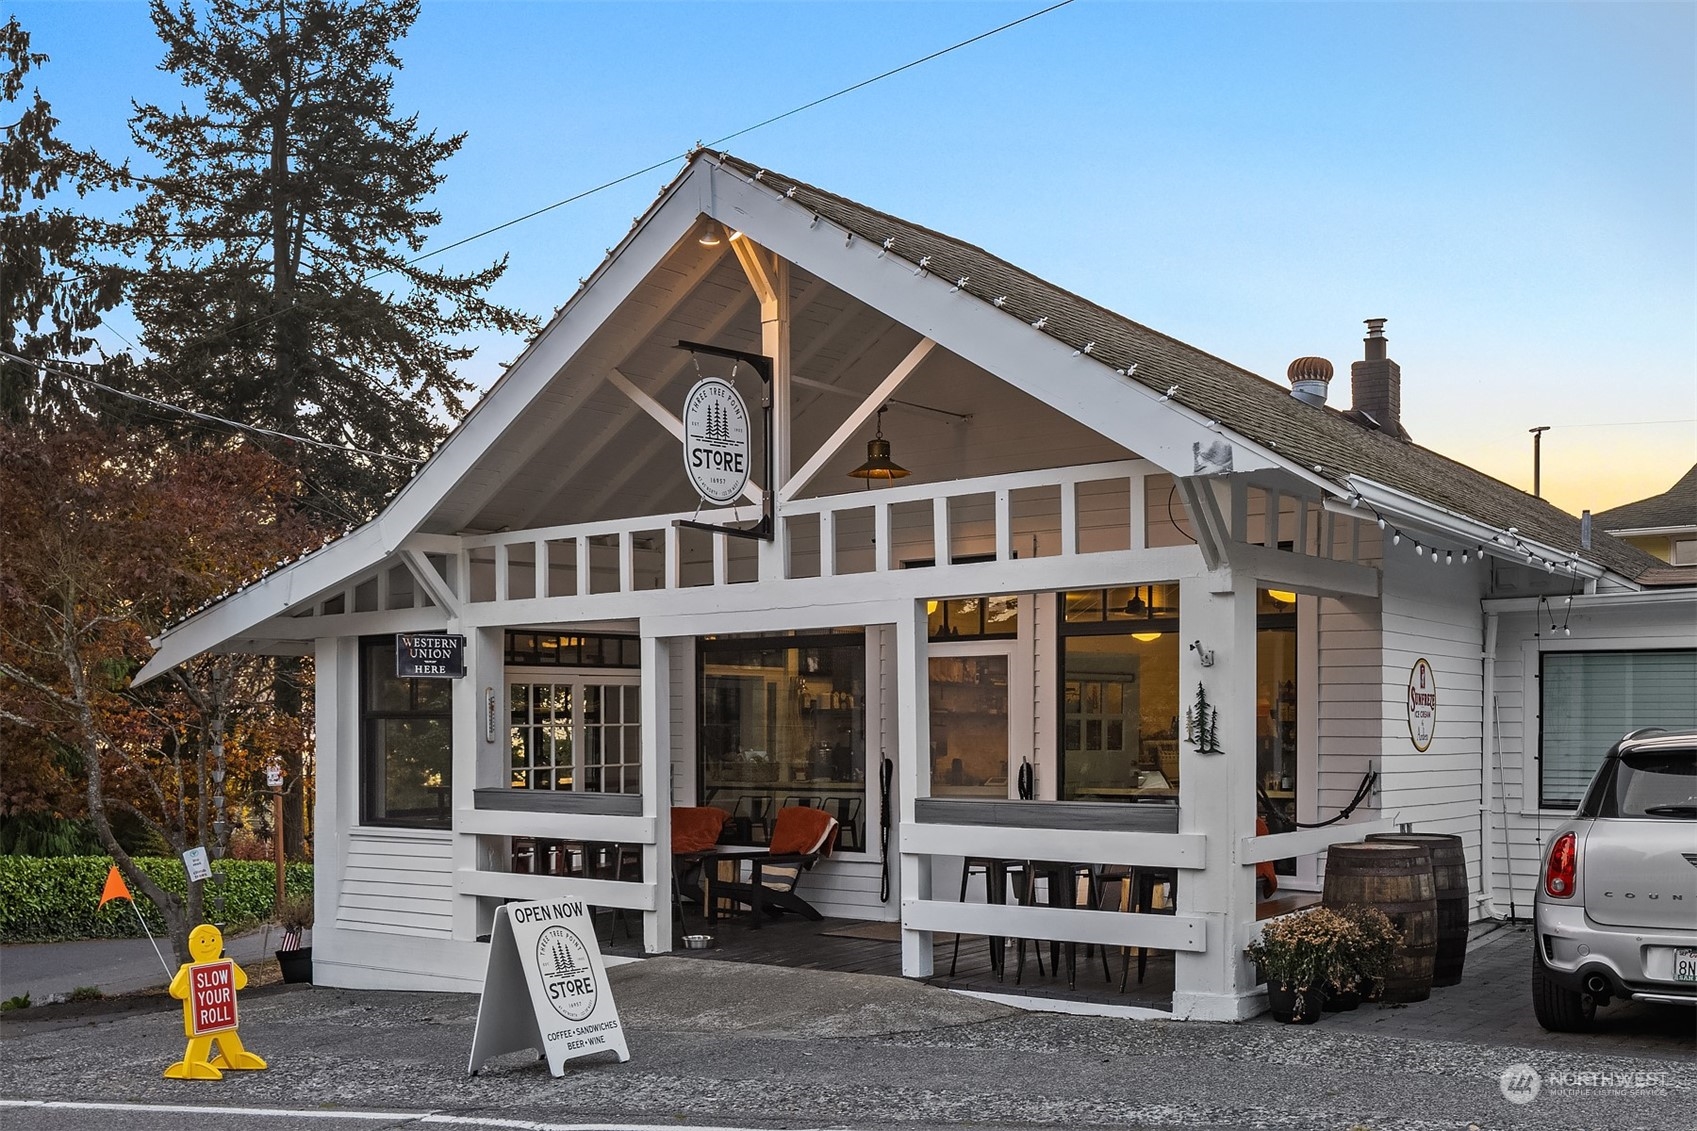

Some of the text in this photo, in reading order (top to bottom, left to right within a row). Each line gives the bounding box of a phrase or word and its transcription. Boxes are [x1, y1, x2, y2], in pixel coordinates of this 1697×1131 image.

[692, 387, 743, 420] THREE TREE POINT
[692, 448, 744, 473] STORE
[402, 637, 458, 648] WESTERN
[409, 649, 452, 659] UNION
[415, 665, 446, 674] HERE
[1604, 892, 1697, 901] COUN
[515, 902, 583, 923] OPEN NOW
[540, 930, 581, 956] THREE TREE POINT
[197, 969, 228, 988] SLOW
[549, 977, 593, 999] STORE
[198, 987, 230, 1006] YOUR
[201, 1006, 231, 1025] ROLL
[547, 1020, 618, 1041] COFFEE SANDWICHES
[567, 1035, 605, 1050] BEER WINE
